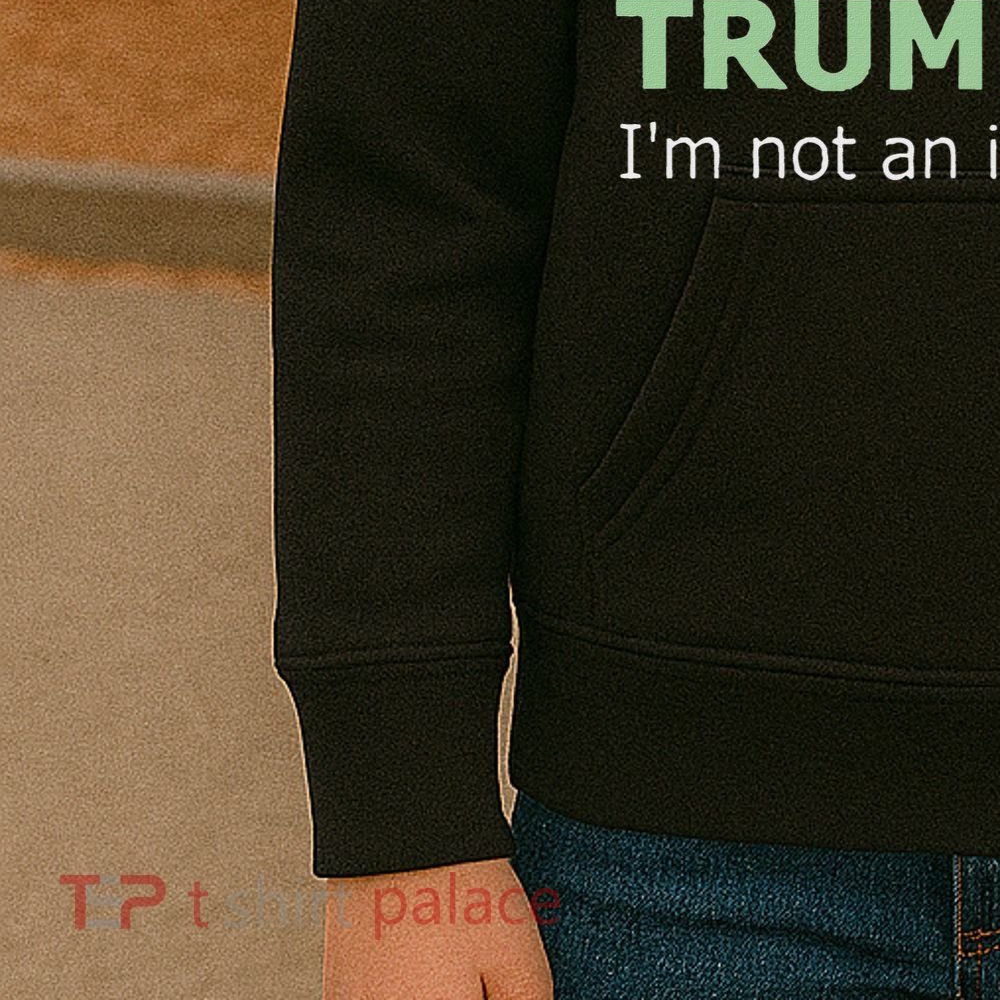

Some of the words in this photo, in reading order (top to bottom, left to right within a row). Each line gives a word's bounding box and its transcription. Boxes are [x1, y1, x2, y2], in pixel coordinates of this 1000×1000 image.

[619, 121, 721, 180] I'm
[752, 125, 857, 182] not
[881, 136, 957, 181] an
